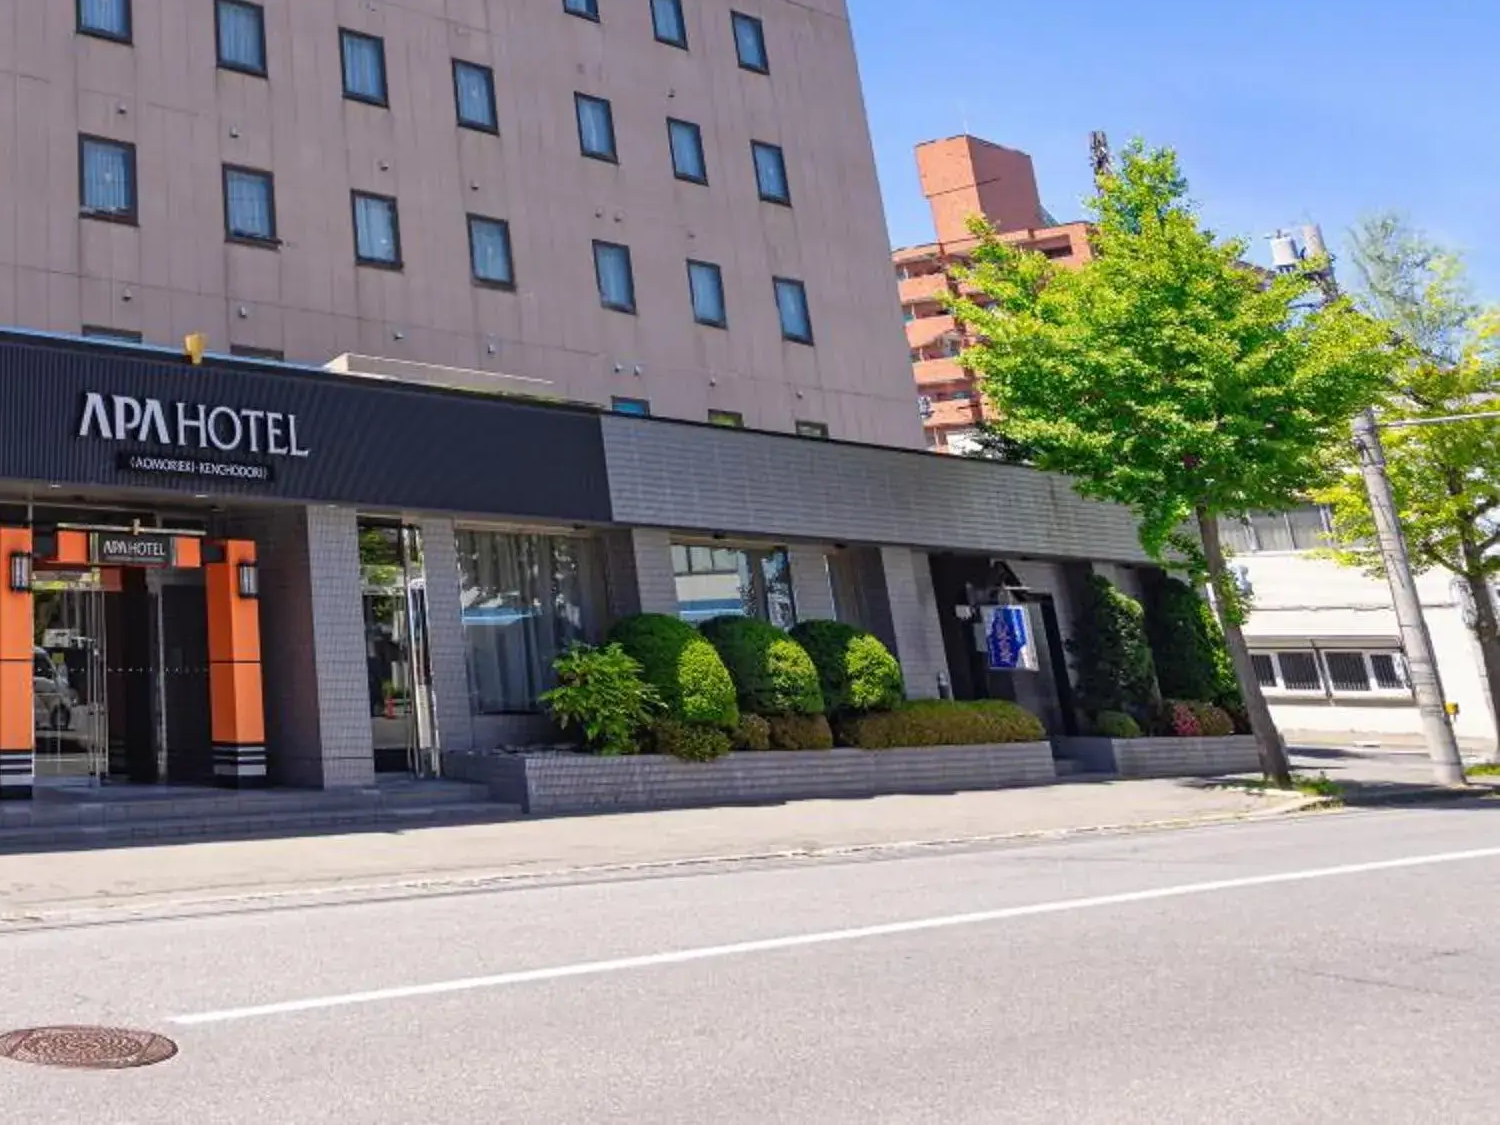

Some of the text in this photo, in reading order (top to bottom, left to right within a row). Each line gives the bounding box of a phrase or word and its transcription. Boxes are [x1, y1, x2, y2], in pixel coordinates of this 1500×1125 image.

[79, 392, 309, 457] APA HOTEL
[128, 541, 165, 556] HOTEL
